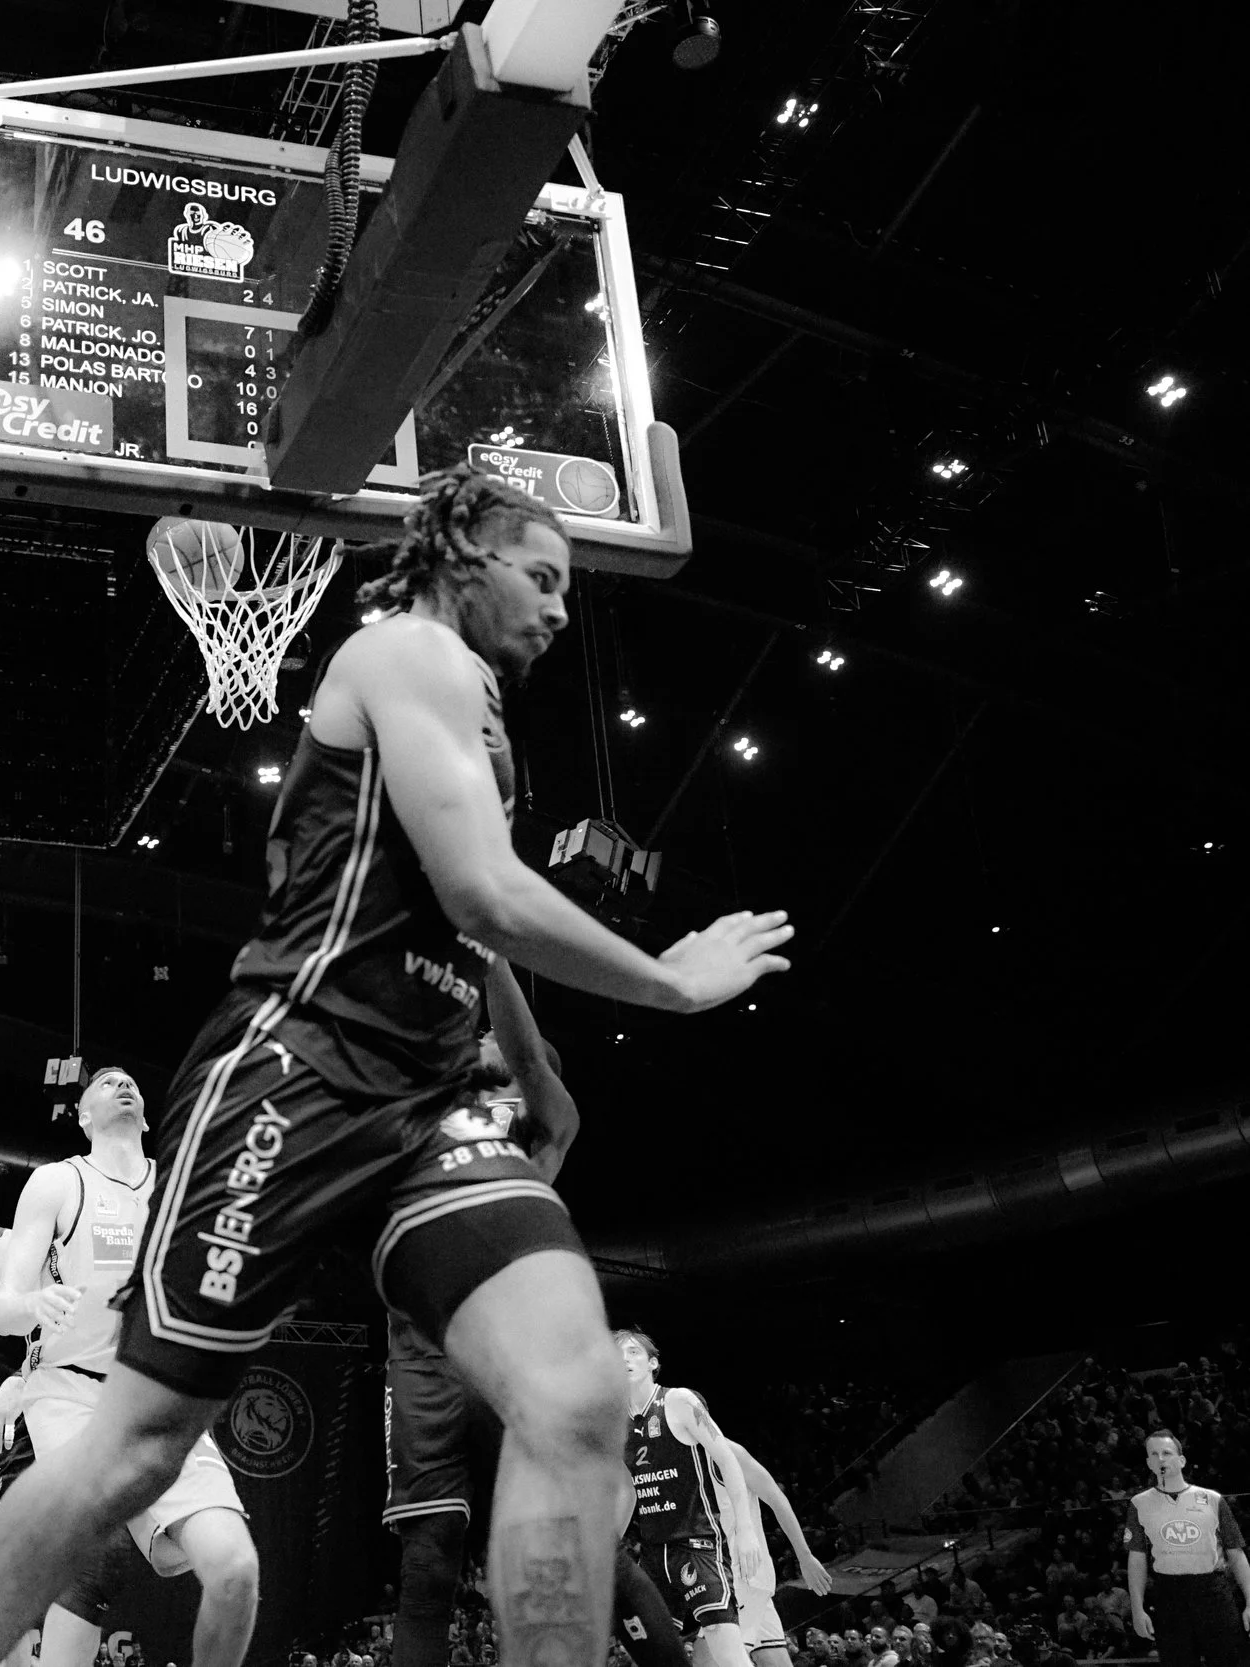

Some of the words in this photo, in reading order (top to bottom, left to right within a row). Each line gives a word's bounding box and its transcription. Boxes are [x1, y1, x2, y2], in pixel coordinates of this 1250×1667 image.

[91, 163, 277, 206] LUDWIGSBURG
[63, 217, 106, 244] 46
[173, 242, 204, 254] MHP
[42, 260, 108, 282] SCOTT
[173, 264, 238, 279] LUDWIGSBURG
[42, 279, 127, 306] PATRICK,
[131, 291, 159, 308] JA.
[243, 289, 254, 303] 2
[262, 292, 274, 306] 4
[41, 297, 105, 319] SIMON
[19, 314, 33, 329] 6
[41, 317, 128, 344] PATRICK,
[131, 329, 161, 346] JO.
[244, 326, 255, 340] 7
[265, 329, 273, 343] 1
[19, 332, 32, 348] 8
[40, 334, 166, 364] MALDONADO
[244, 344, 256, 359] 0
[266, 347, 274, 361] 1
[8, 351, 31, 367] 13
[40, 354, 107, 377] POLAS
[244, 364, 257, 378] 4
[265, 366, 277, 380] 3
[7, 370, 32, 387] 15
[39, 372, 123, 399] MANJON
[236, 381, 257, 397] 10
[266, 385, 278, 400] 0
[236, 400, 258, 416] 16
[1, 412, 104, 446] Credit
[247, 421, 258, 436] 0
[114, 442, 145, 459] JR.
[480, 451, 519, 468] e@sy
[499, 464, 544, 480] Credit
[437, 1145, 474, 1173] 28
[92, 1225, 134, 1240] Sparda
[105, 1235, 134, 1247] Bank
[635, 1446, 651, 1467] 2
[637, 1486, 661, 1499] BANK
